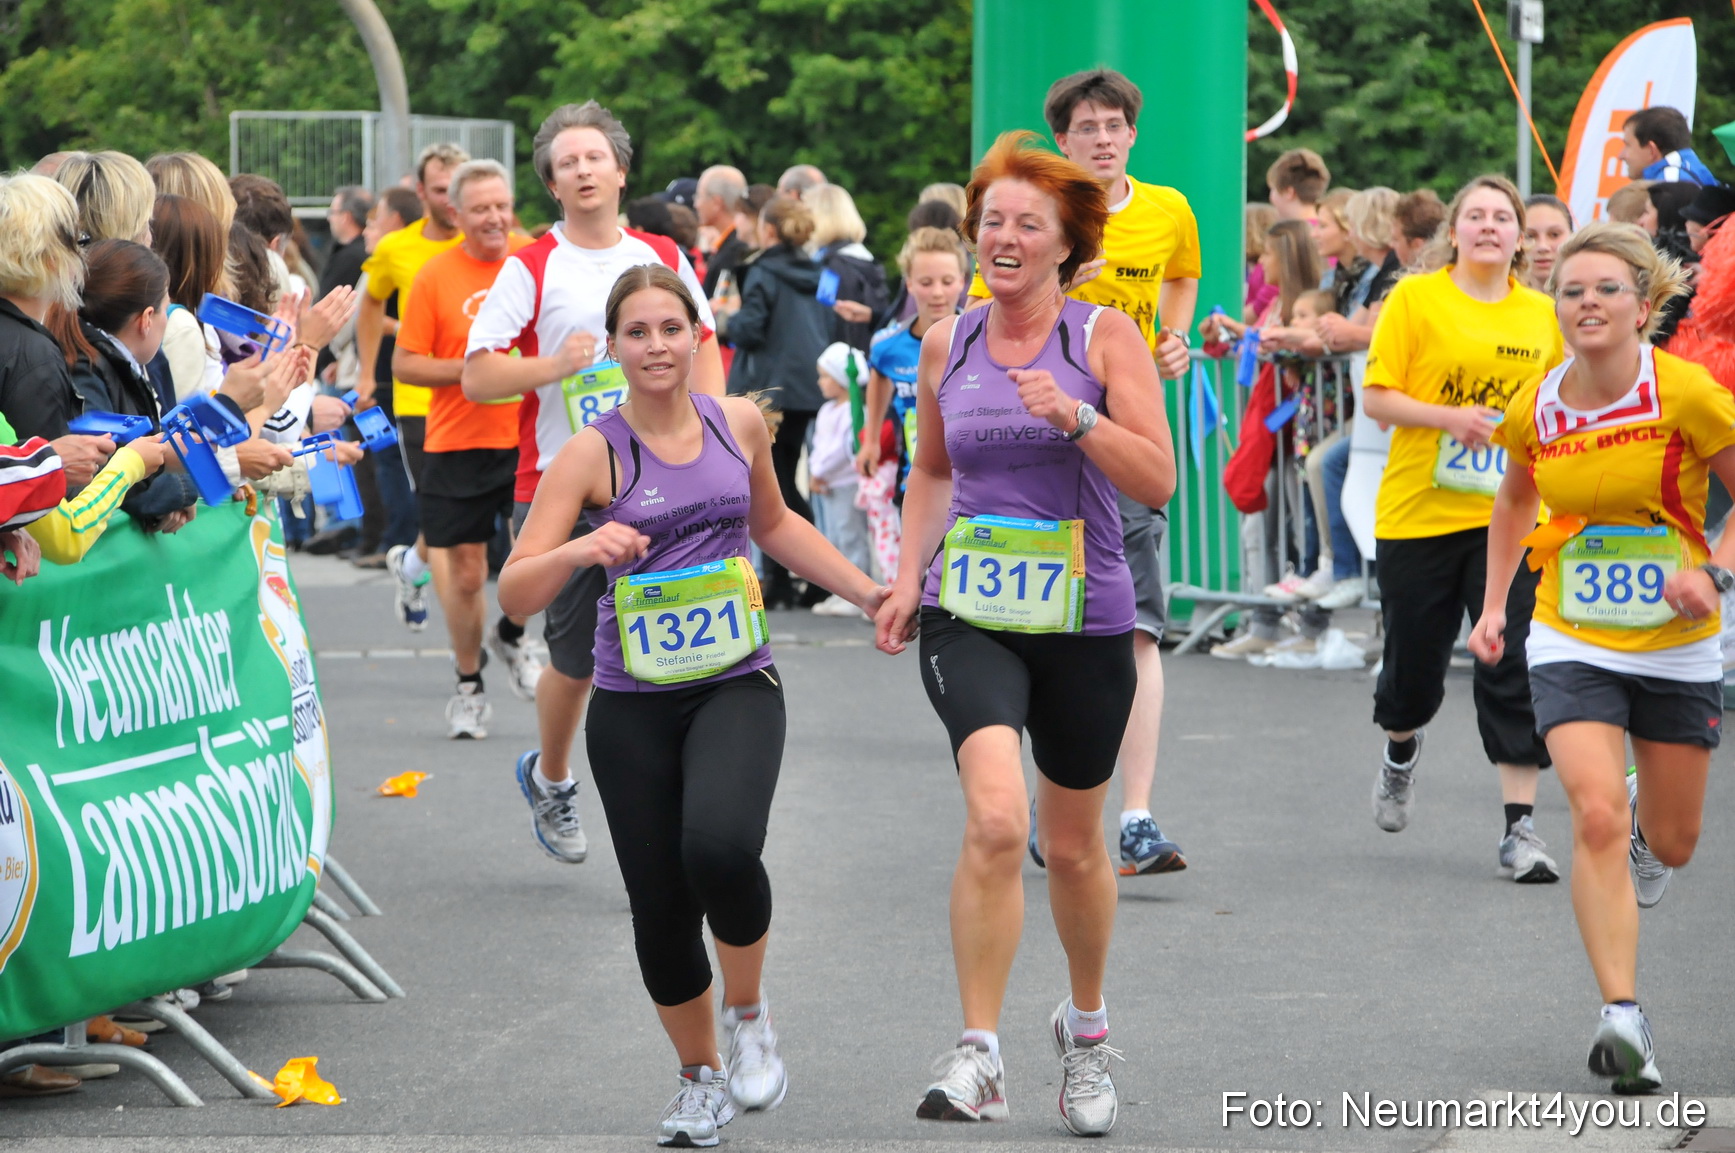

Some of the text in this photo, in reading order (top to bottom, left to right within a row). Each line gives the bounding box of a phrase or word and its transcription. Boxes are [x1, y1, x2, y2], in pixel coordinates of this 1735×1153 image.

[1116, 267, 1149, 278] swn
[1497, 345, 1530, 358] swn
[976, 406, 1013, 418] Stiegler
[1016, 406, 1022, 415] &
[1539, 426, 1665, 460] MAX BÖGL
[630, 511, 669, 530] Manfred
[671, 500, 708, 518] Stiegler
[710, 498, 718, 508] &
[720, 496, 741, 506] Sven
[641, 496, 665, 507] erima
[675, 516, 747, 539] uniVers
[951, 554, 1064, 601] 1317
[1574, 563, 1665, 604] 389
[636, 593, 680, 606] firmenlauf
[975, 601, 1007, 614] Luise
[1587, 605, 1628, 616] Claudia
[629, 600, 740, 655] 1321
[38, 583, 241, 749] Neumarkter
[656, 651, 726, 667] Stefanie Friedel
[27, 718, 307, 958] Lammsbräu
[5, 856, 24, 881] Bier
